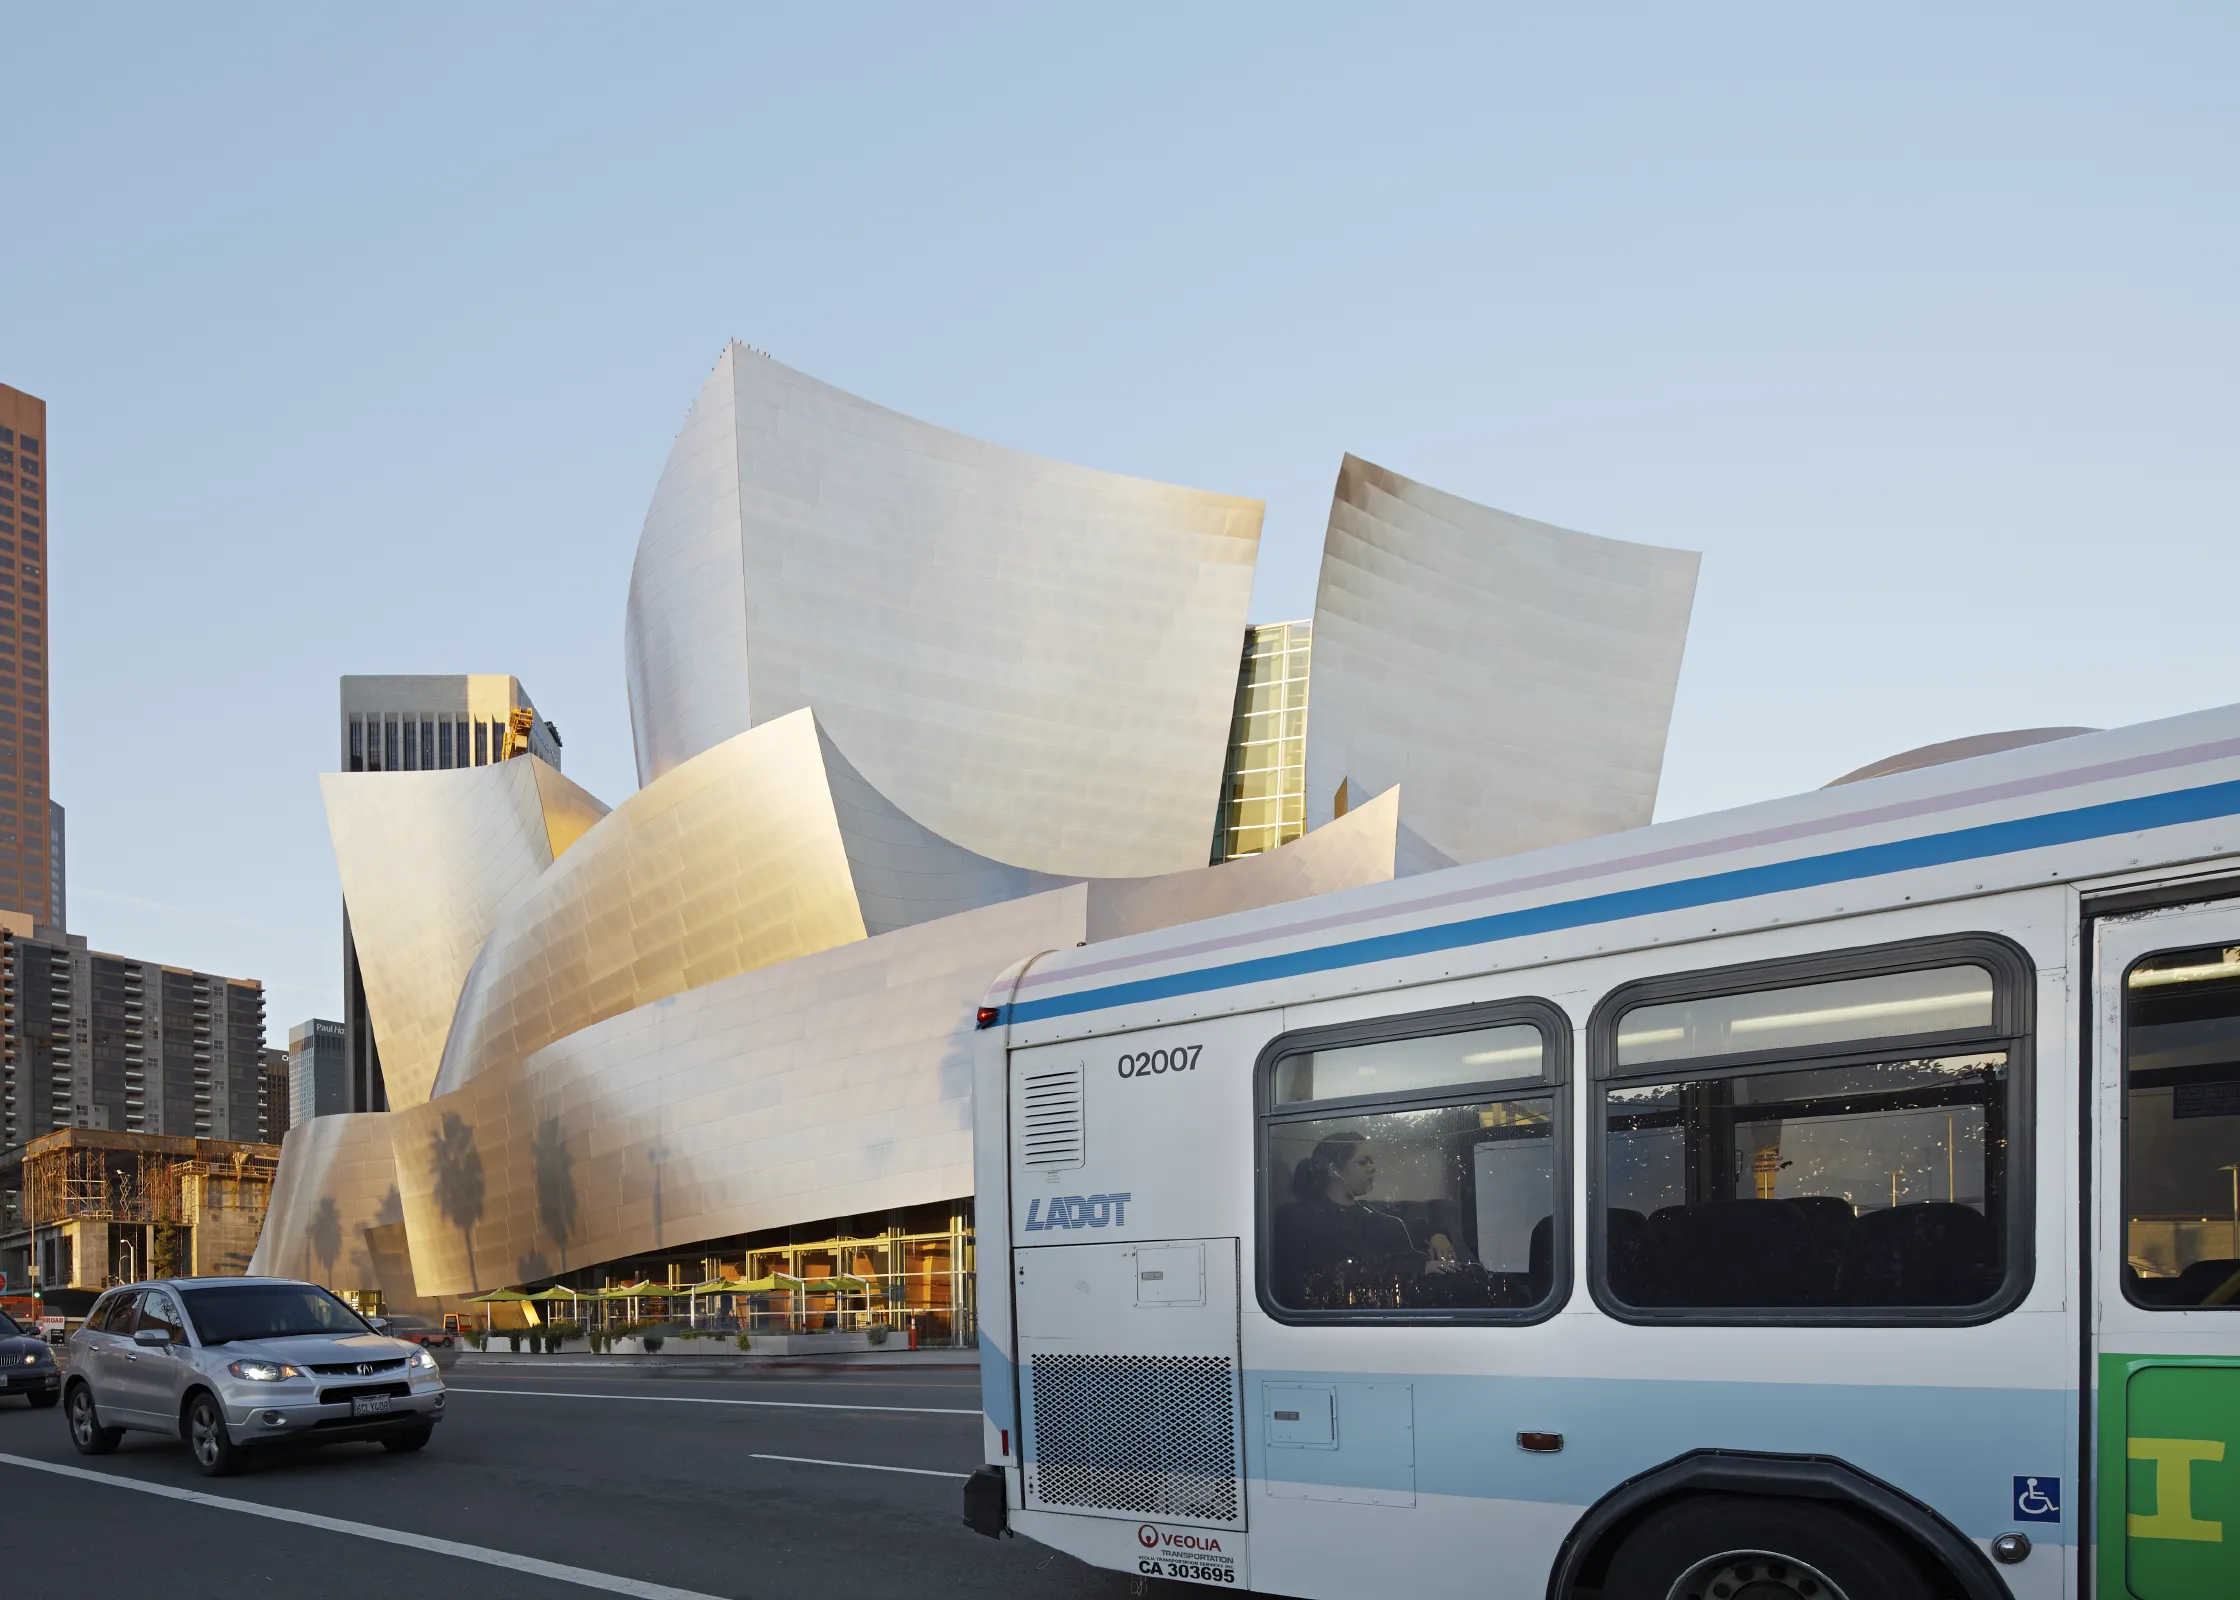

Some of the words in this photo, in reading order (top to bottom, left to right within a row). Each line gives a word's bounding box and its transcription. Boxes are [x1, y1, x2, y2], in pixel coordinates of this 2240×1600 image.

[316, 1023, 333, 1032] Paul
[1118, 1044, 1203, 1079] 02007
[1024, 1192, 1132, 1232] LADOT
[1161, 1533, 1221, 1552] VEOLIA
[1156, 1556, 1199, 1566] TRANSPORTATION
[1161, 1550, 1234, 1564] TRANSPORTATION
[1139, 1561, 1163, 1575] CA
[1167, 1563, 1235, 1583] 303695
